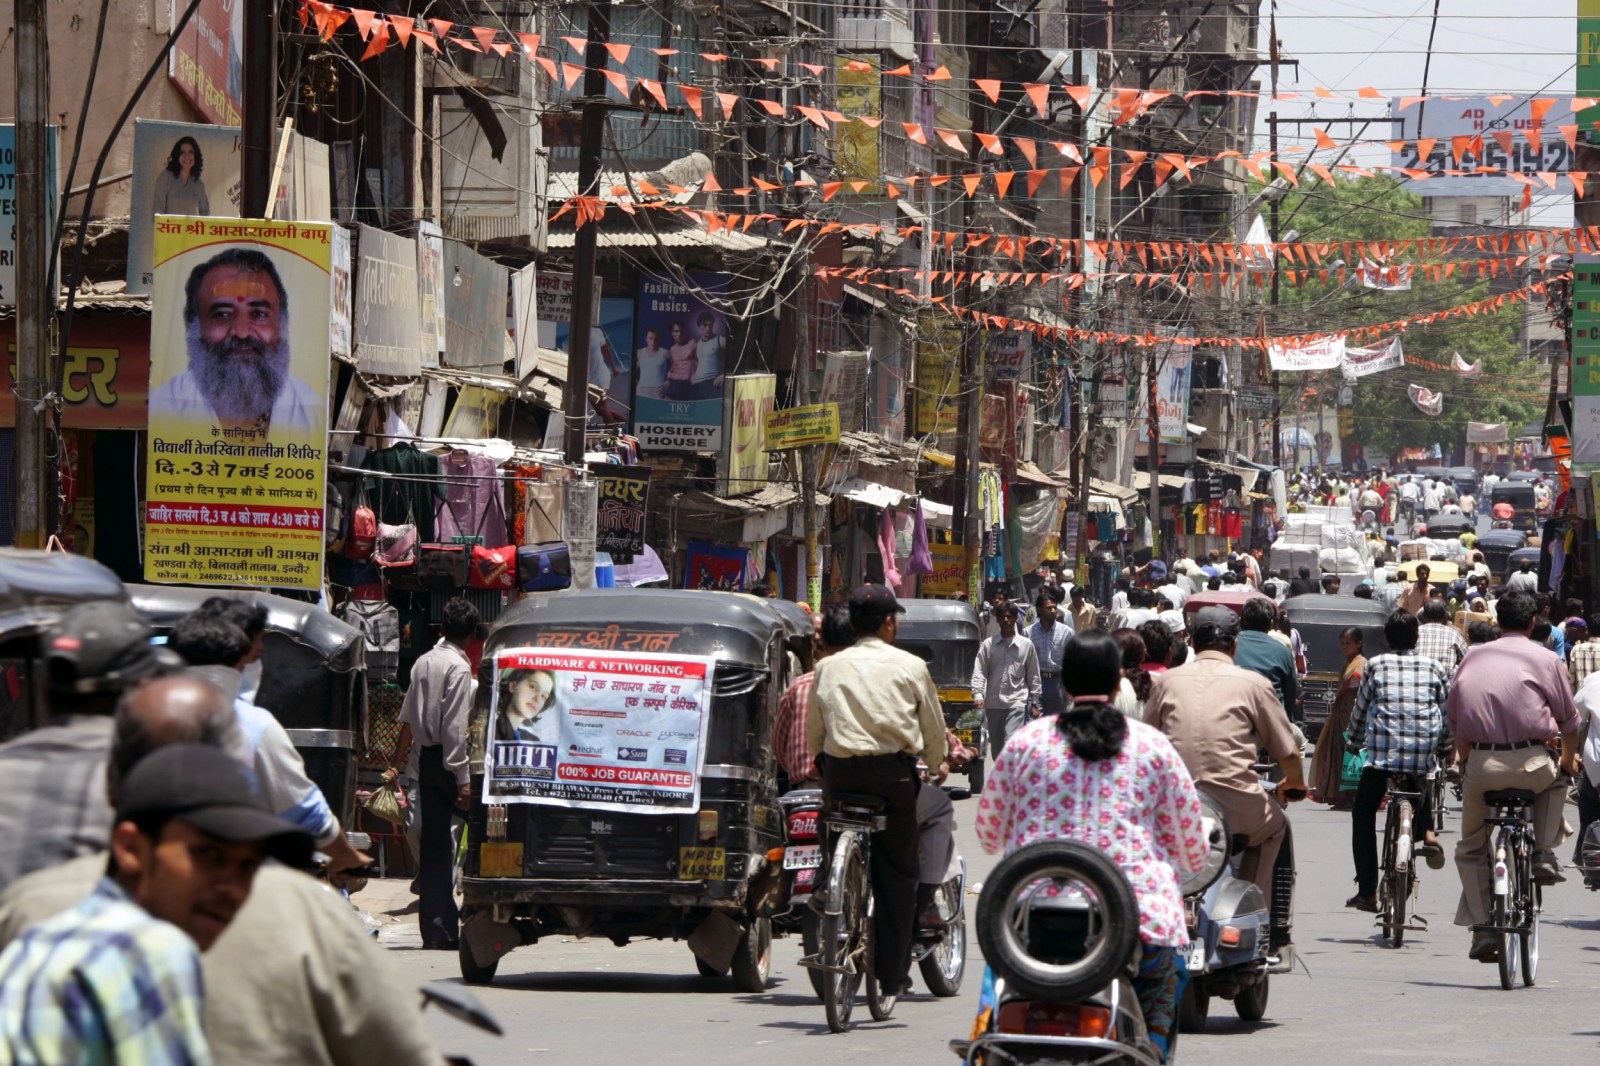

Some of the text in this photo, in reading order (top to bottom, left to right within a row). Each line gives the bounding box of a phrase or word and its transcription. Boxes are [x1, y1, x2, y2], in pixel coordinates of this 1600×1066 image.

[1461, 109, 1485, 119] AD
[157, 219, 330, 244] संत श्री आसारामजी बापू
[652, 299, 690, 312] Basics.
[211, 425, 220, 437] के
[258, 428, 267, 439] में
[640, 425, 716, 437] HOSIERY
[153, 438, 321, 461] विद्यार्थी तेजस्विता तालीम शिविर
[647, 437, 708, 447] HOUSE
[206, 459, 220, 476] से
[224, 464, 237, 478] 7
[239, 463, 271, 479] मई
[274, 467, 315, 481] 2006
[184, 483, 194, 495] दो
[197, 484, 214, 496] दिन
[217, 487, 238, 499] पूज्य
[241, 485, 253, 497] श्री
[256, 486, 265, 497] के
[149, 504, 173, 522] जाहिर
[174, 506, 199, 522] सत्संग
[220, 512, 229, 523] व
[229, 511, 237, 524] 4
[238, 507, 251, 525] को
[252, 512, 270, 525] शाम
[271, 512, 293, 527] 4:30
[294, 509, 310, 527] बजे
[311, 510, 321, 528] से
[148, 542, 319, 562] संत श्री आसाराम जी आश्रम
[153, 559, 186, 569] खण्डवा
[208, 559, 248, 571] बिलावली
[282, 562, 310, 575] इन्दौर
[157, 570, 179, 579] फोन
[622, 632, 681, 653] राम
[518, 656, 684, 675] HARDWARE & NETWORKING
[590, 679, 607, 691] एक
[611, 680, 644, 693] साधारण
[670, 685, 681, 695] या
[624, 696, 639, 708] एक
[616, 729, 652, 737] ORACLE
[498, 745, 555, 769] IIHT
[630, 749, 647, 759] Sun
[560, 766, 692, 785] 100% JOB GUARANTEE
[626, 795, 655, 805] Lines)
[652, 791, 689, 800] INDORE
